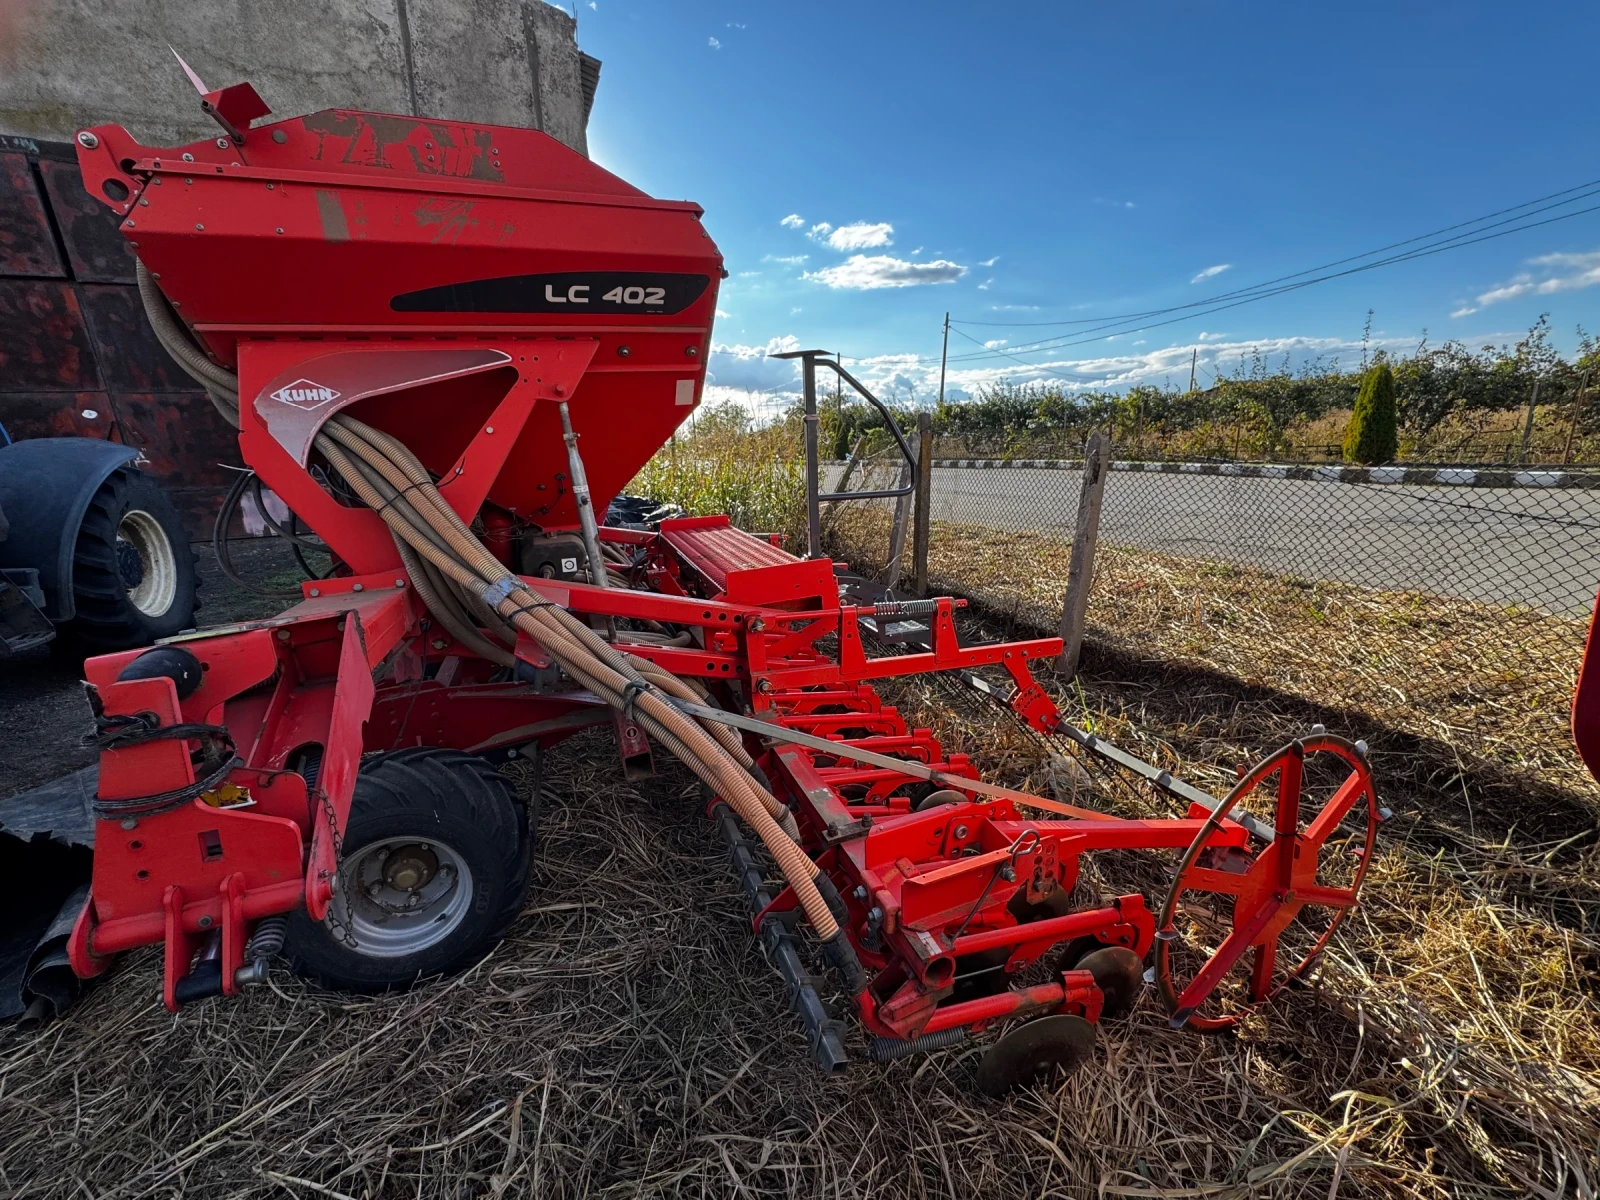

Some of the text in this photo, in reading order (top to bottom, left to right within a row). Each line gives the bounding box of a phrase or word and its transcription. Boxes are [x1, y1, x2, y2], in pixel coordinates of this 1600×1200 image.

[545, 284, 666, 305] LC 402
[279, 388, 333, 402] KUHN
